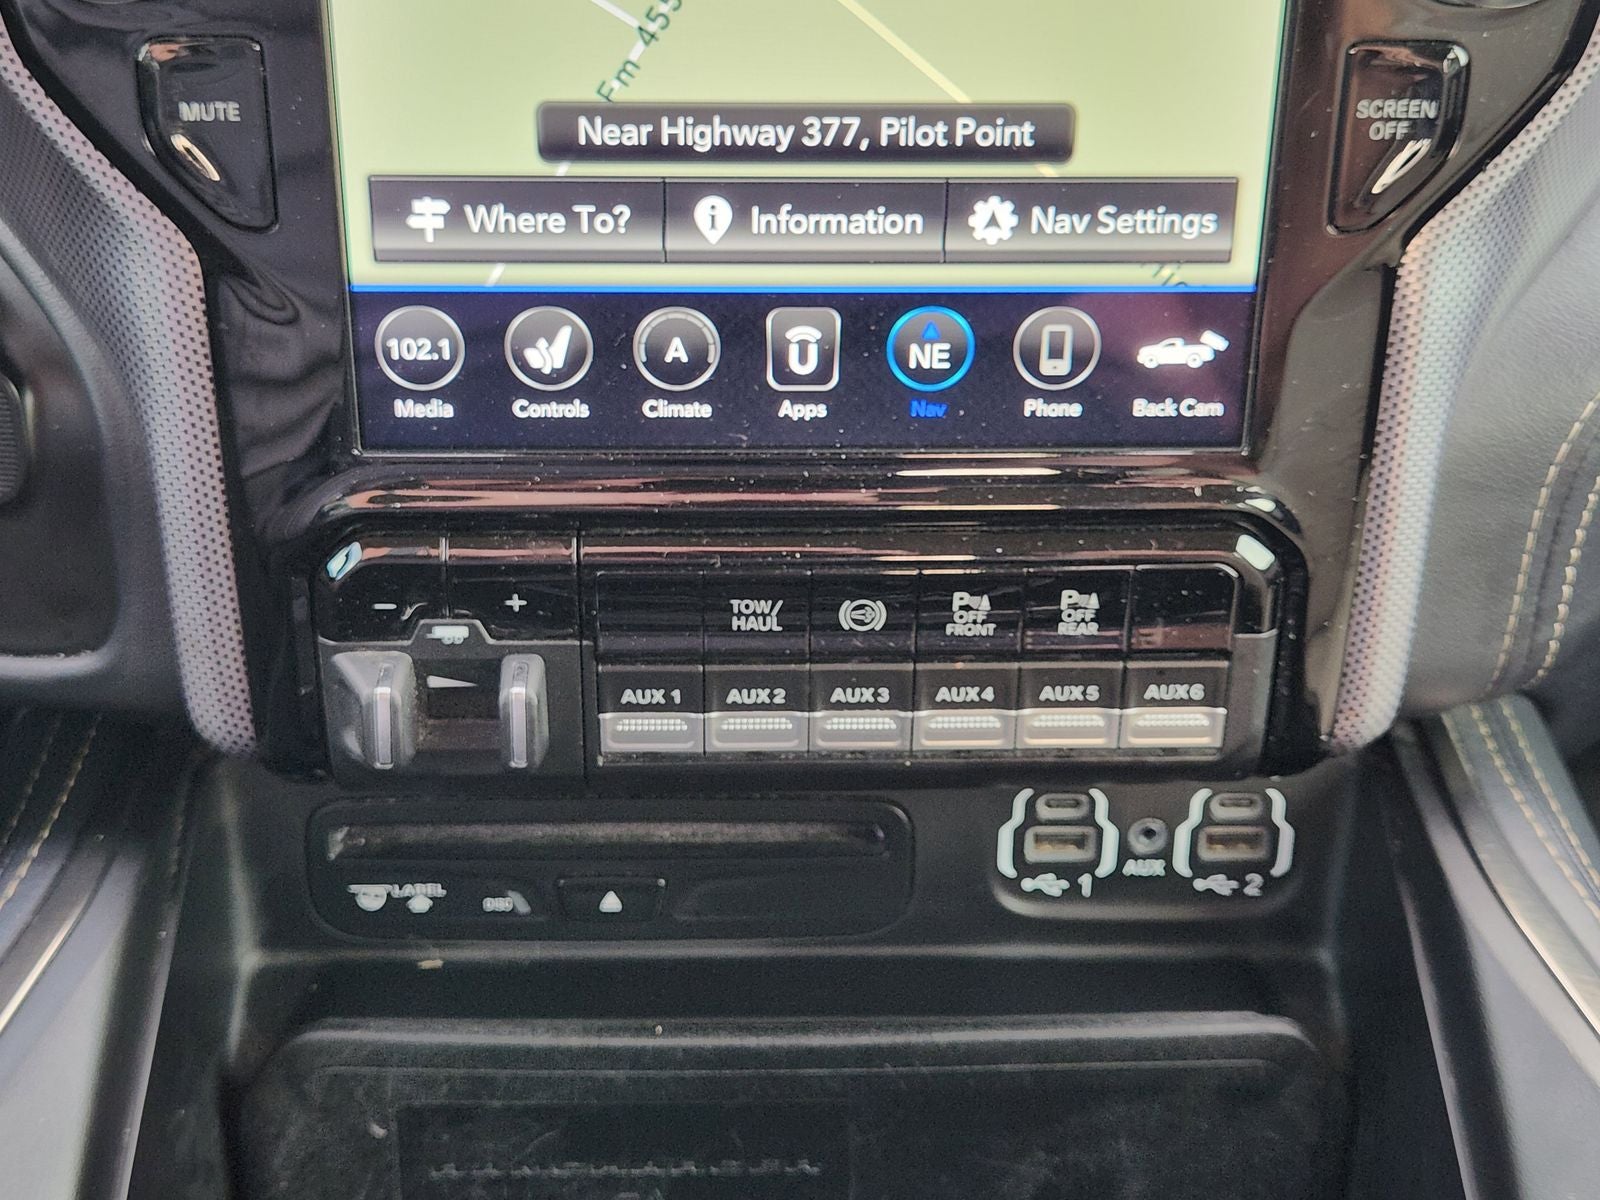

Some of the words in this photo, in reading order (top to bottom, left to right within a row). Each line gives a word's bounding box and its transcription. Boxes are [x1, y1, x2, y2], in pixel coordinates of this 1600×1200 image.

[178, 101, 241, 122] MUTE
[1356, 99, 1439, 120] SCREEN
[577, 116, 653, 147] Near
[660, 115, 795, 152] Highway
[801, 117, 870, 151] 377,
[879, 116, 948, 147] Pilot
[955, 118, 1036, 147] Point
[1369, 120, 1409, 140] OFF
[464, 204, 566, 234] Where
[572, 204, 632, 234] To?
[751, 204, 925, 236] Information
[1030, 206, 1092, 235] Nav
[1096, 206, 1219, 240] Settings
[385, 337, 452, 362] 102.1
[664, 337, 689, 364] A
[908, 342, 952, 371] NE
[394, 400, 455, 420] Media
[512, 399, 591, 420] Controls
[642, 399, 713, 420] Climate
[778, 400, 828, 421] Apps
[911, 400, 948, 419] Nav
[1023, 399, 1083, 419] Phone
[1132, 399, 1177, 418] Back
[1179, 400, 1224, 418] Cam
[730, 599, 784, 615] TOW/
[1061, 610, 1096, 623] OFF
[731, 615, 783, 632] HAUL
[953, 611, 988, 624] OFF
[945, 624, 997, 637] FRONT
[1057, 622, 1099, 636] REAR
[620, 688, 666, 705] AUX
[670, 689, 681, 704] 1
[725, 688, 773, 705] AUX
[775, 688, 787, 704] 2
[830, 687, 877, 703] AUX
[877, 687, 890, 703] 3
[935, 686, 980, 702] AUX
[980, 686, 995, 702] 4
[1039, 685, 1084, 702] AUX
[1085, 685, 1100, 702] 5
[1143, 684, 1189, 700] AUX
[1189, 684, 1205, 700] 6
[1077, 873, 1093, 897] 1
[1243, 873, 1264, 896] 2
